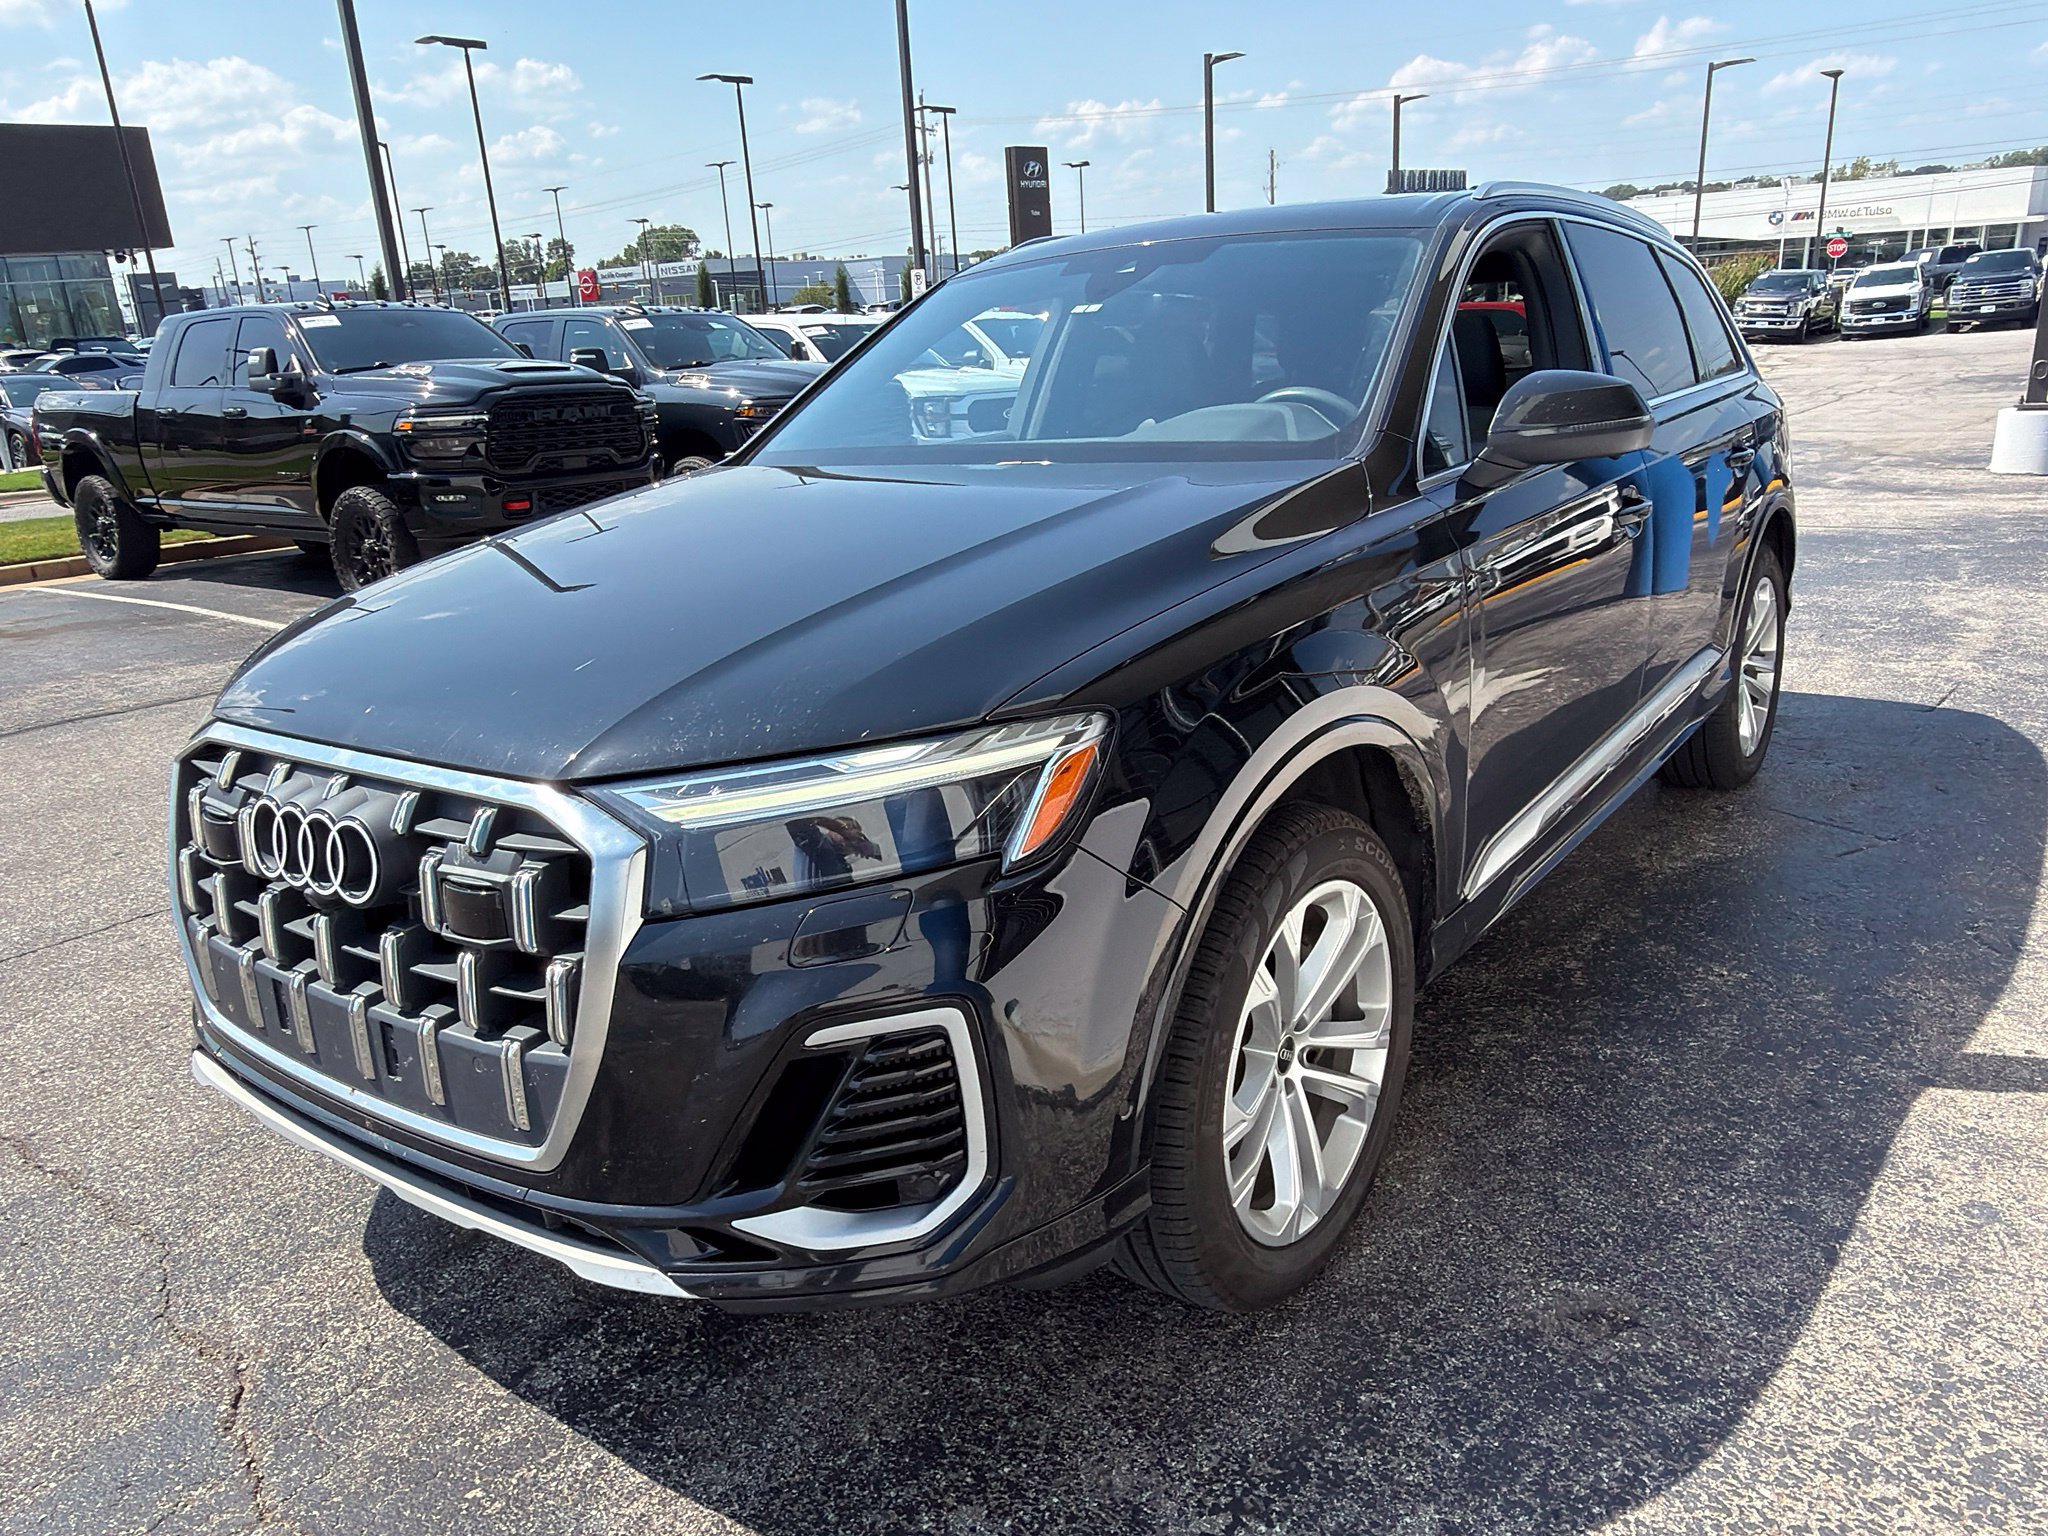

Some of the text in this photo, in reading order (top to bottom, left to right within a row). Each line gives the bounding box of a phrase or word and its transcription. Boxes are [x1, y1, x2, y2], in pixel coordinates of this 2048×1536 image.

[1020, 180, 1047, 188] HYUNDAI
[1849, 207, 1862, 217] of
[1863, 206, 1893, 216] Tulsa
[1828, 243, 1847, 252] STOP
[660, 264, 700, 276] NISSAN
[533, 405, 608, 422] RAM
